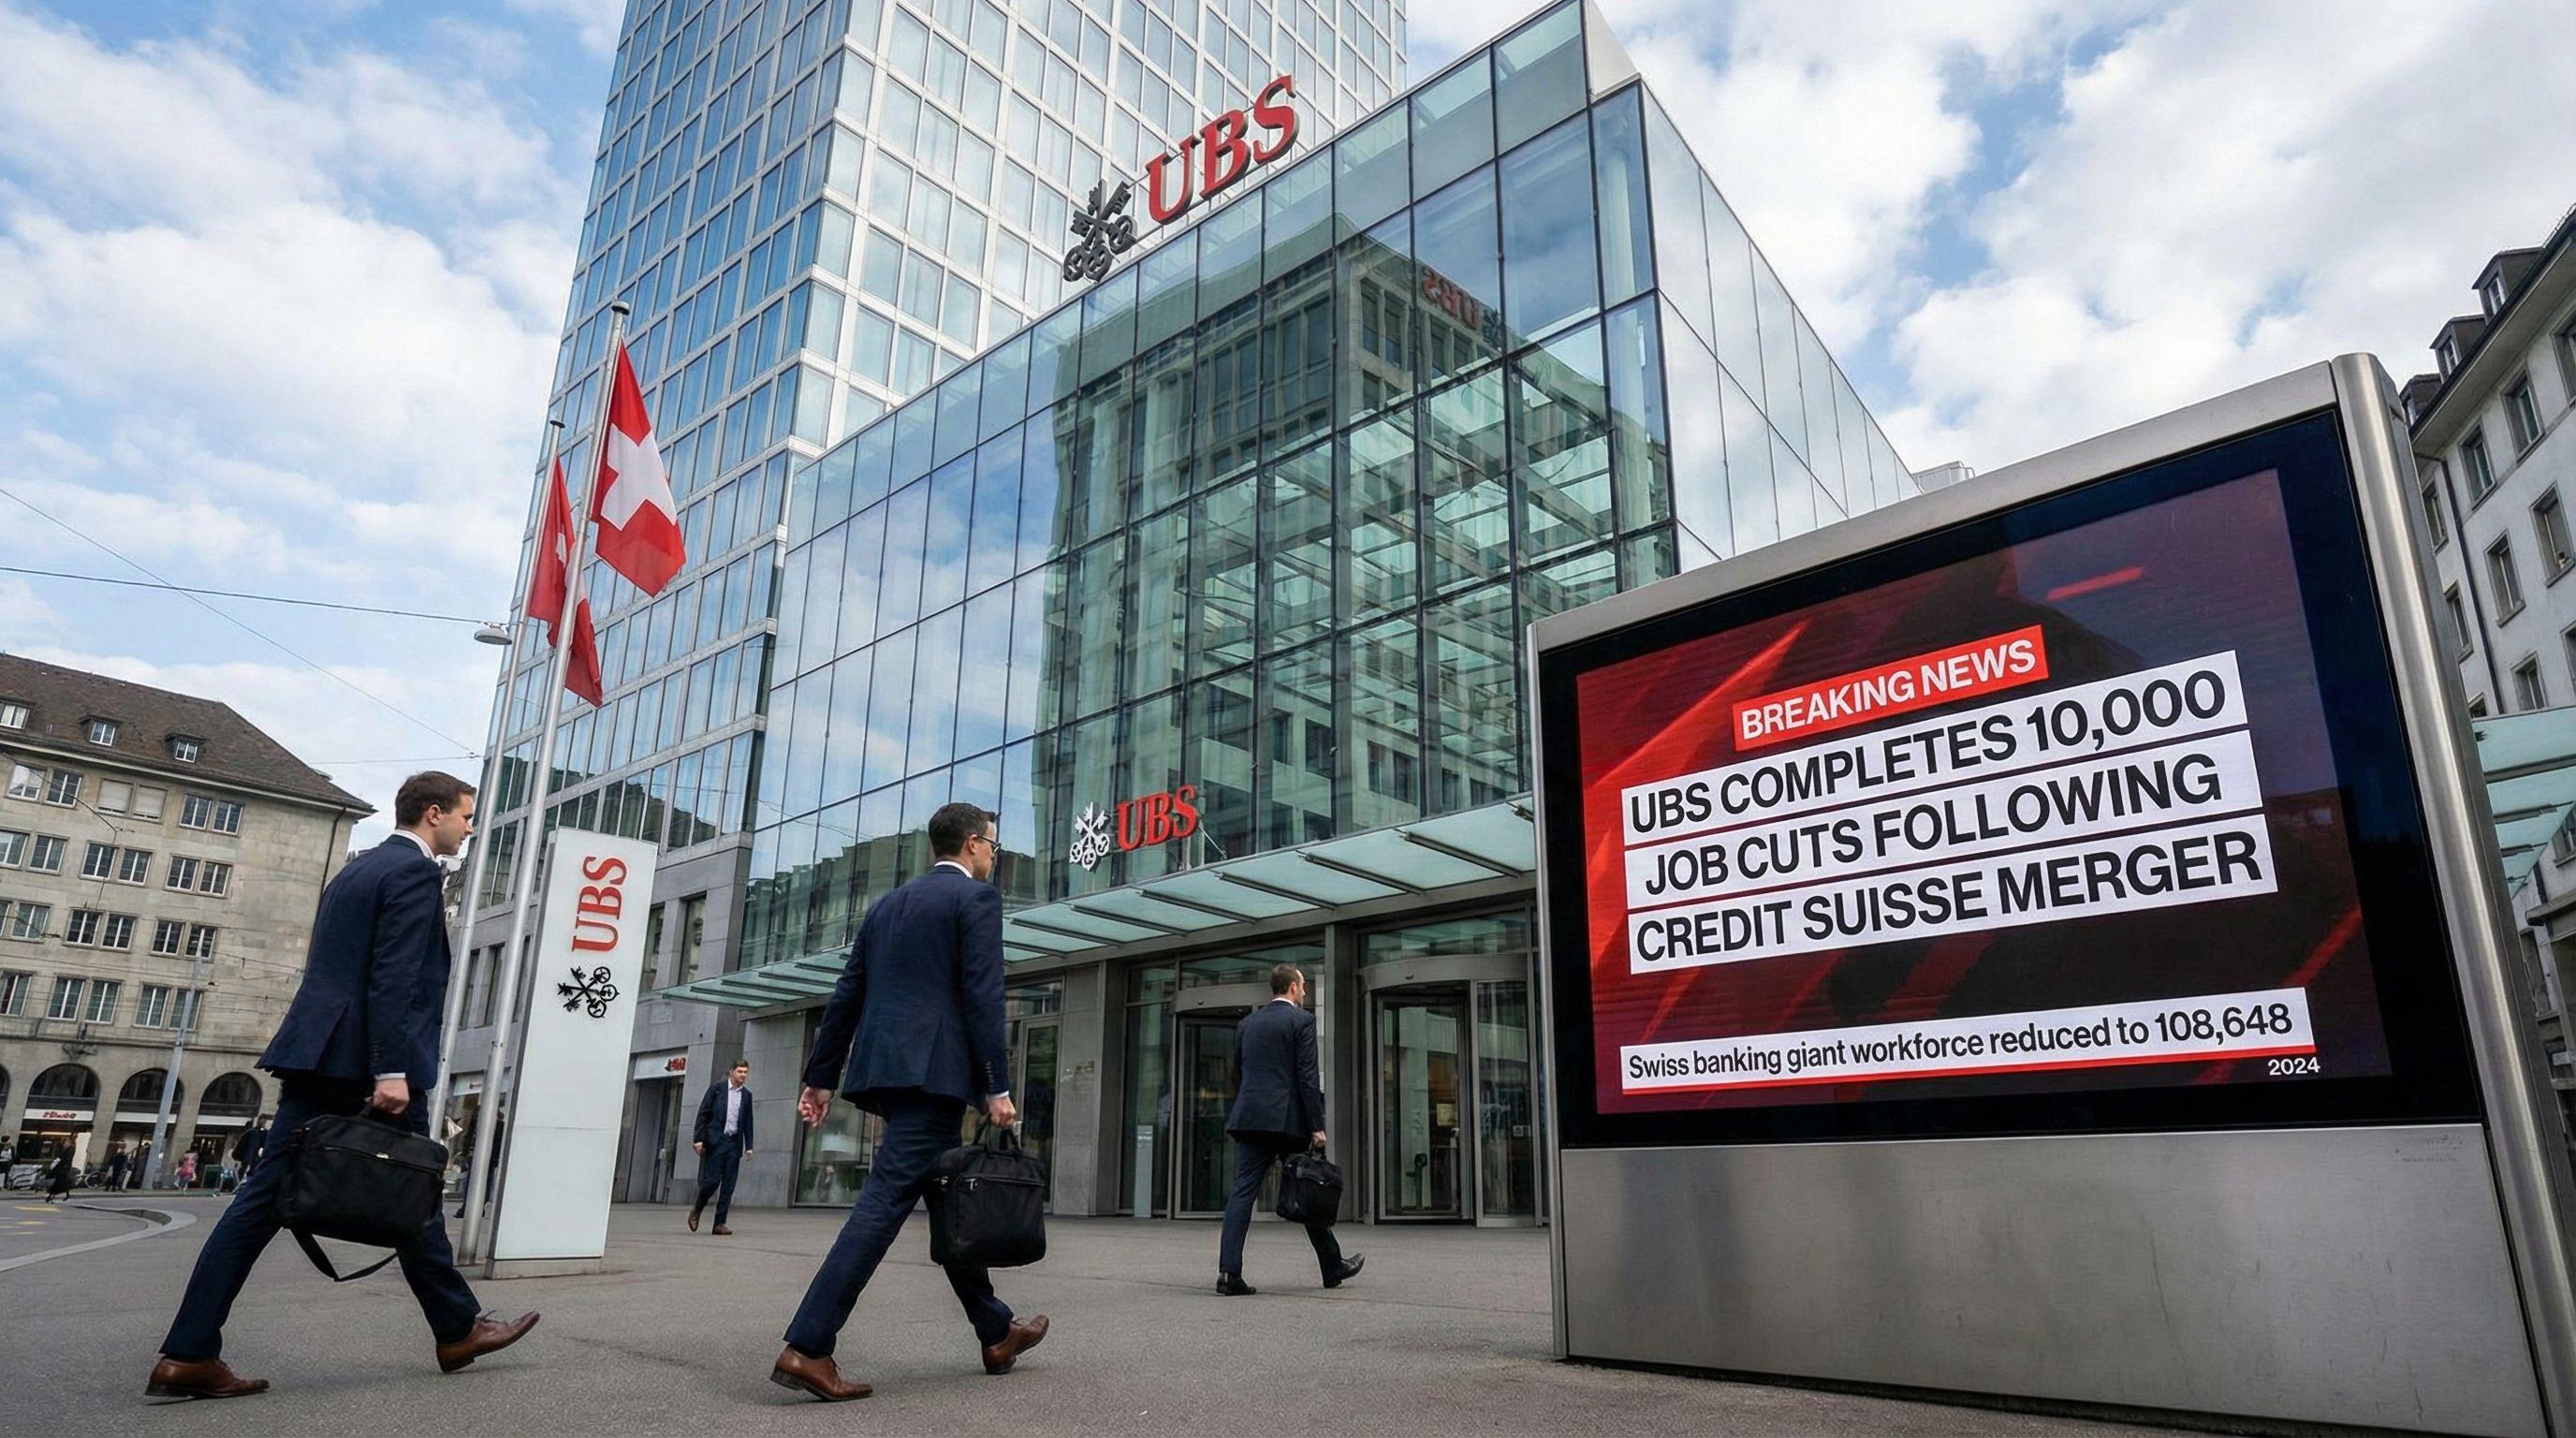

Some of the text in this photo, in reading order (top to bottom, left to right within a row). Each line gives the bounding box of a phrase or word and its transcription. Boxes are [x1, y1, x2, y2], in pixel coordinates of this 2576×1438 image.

[1145, 75, 1300, 225] UBS
[1742, 640, 2035, 739] BREAKING NEWS
[1632, 670, 2225, 832] UBS COMPLETES 10,000
[1117, 785, 1197, 851] UBS
[1647, 754, 2221, 895] JOB CUTS FOLLOWING
[572, 856, 627, 952] UBS
[1637, 831, 2262, 961] CREDIT SUISSE MERGER
[1630, 1004, 2292, 1078] Swiss banking giant workforce reduced to 108,648
[2268, 1057, 2320, 1075] 2024
